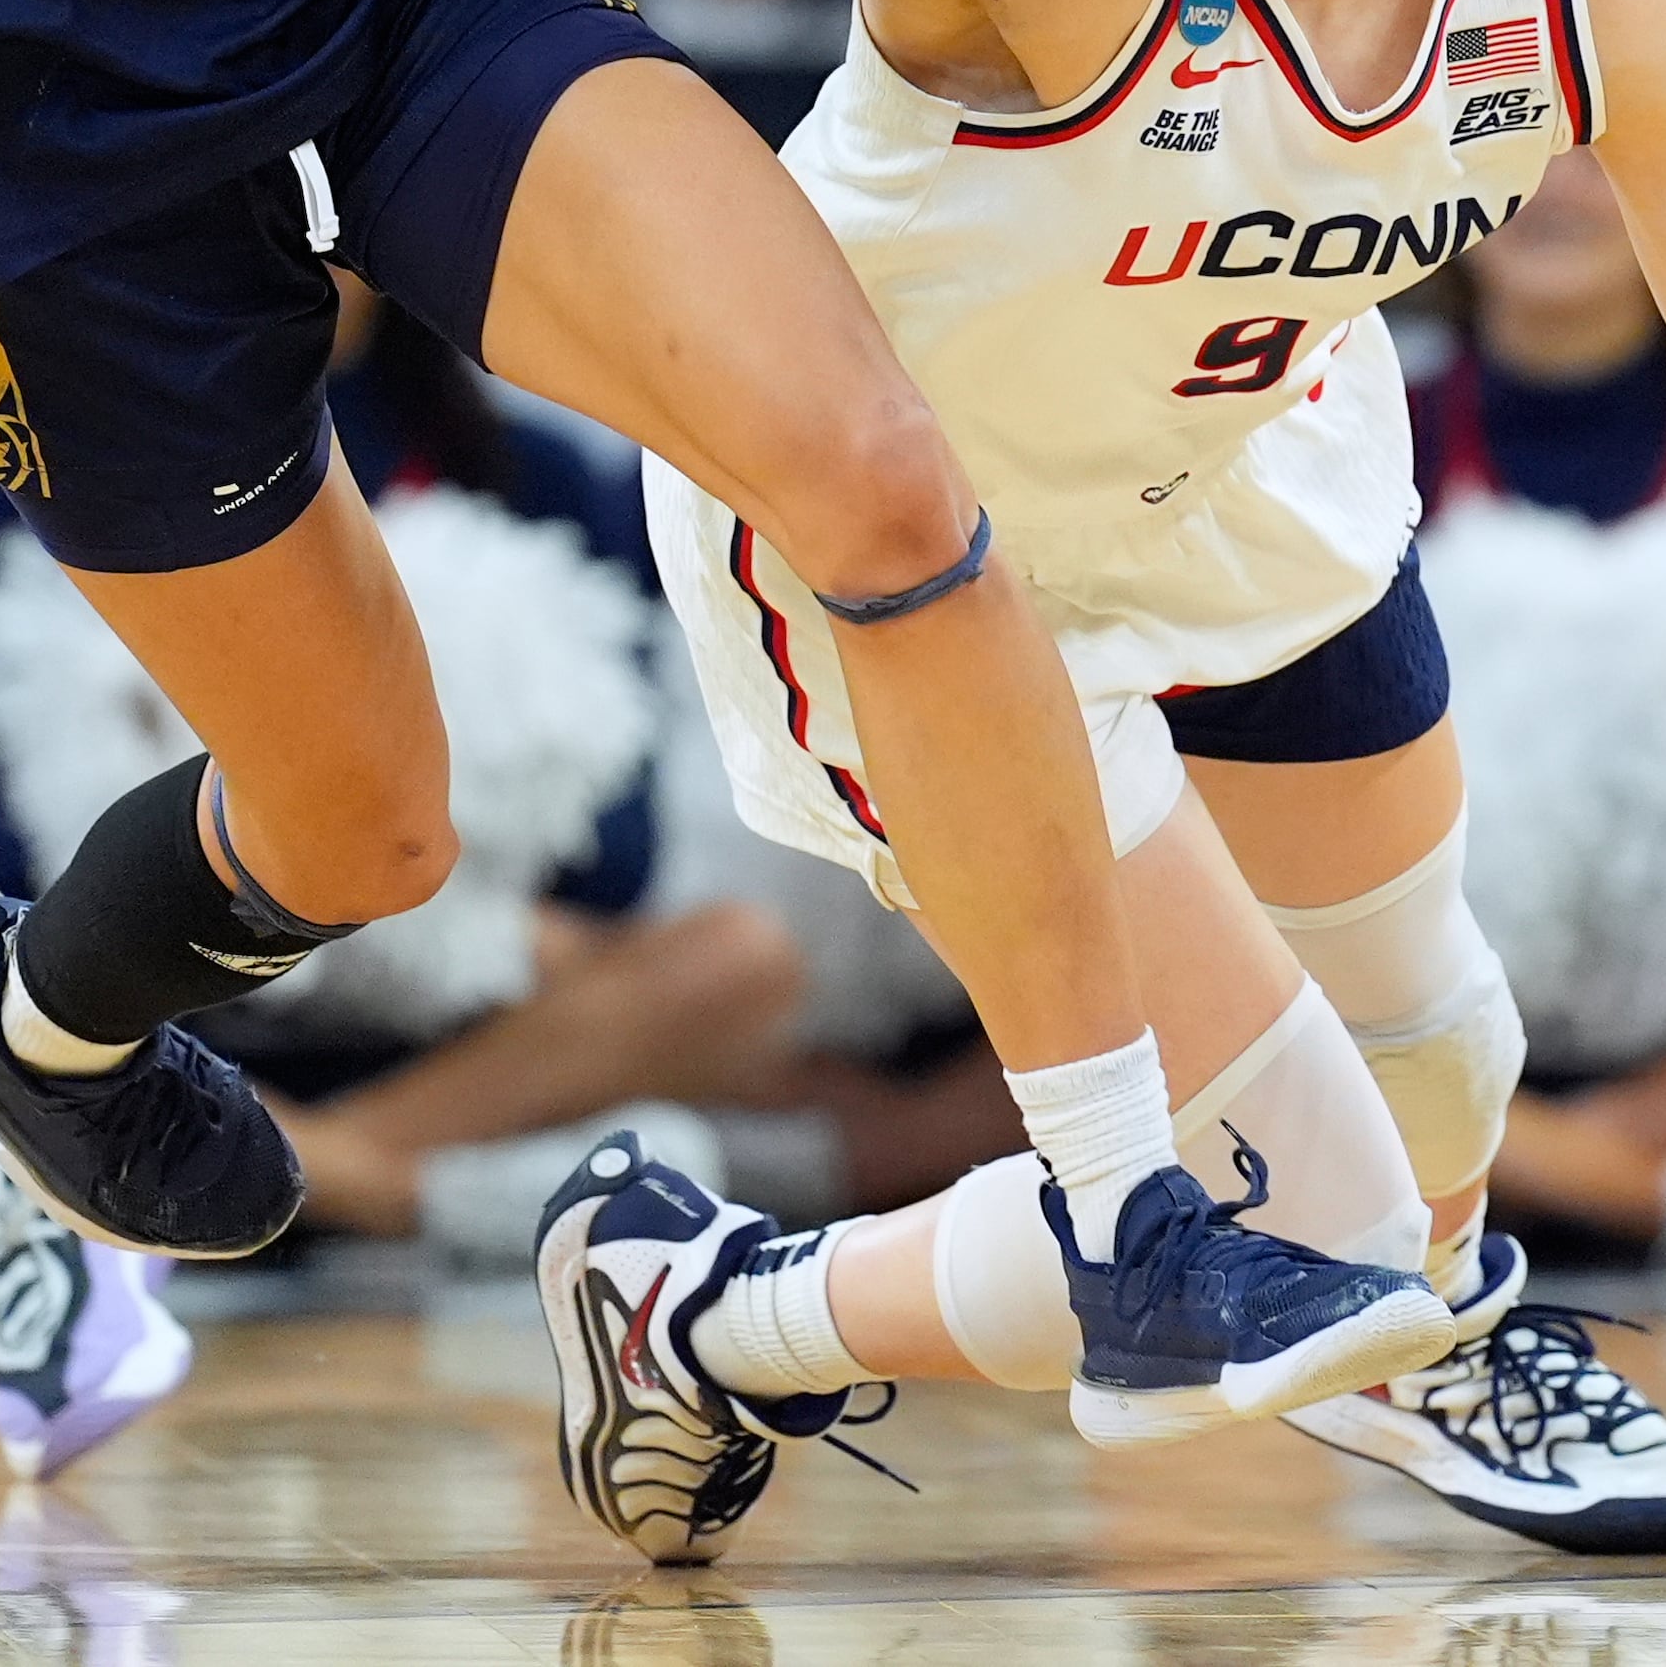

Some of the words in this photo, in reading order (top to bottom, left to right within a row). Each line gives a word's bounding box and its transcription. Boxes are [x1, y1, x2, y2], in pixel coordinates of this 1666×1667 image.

[1183, 4, 1229, 28] NCAA
[1462, 88, 1531, 116] BIG
[1155, 109, 1188, 131] BE
[1191, 108, 1220, 132] THE
[1452, 104, 1550, 135] EAST
[1139, 127, 1219, 153] CHANGE
[1102, 193, 1523, 287] UCONN
[1170, 315, 1309, 398] 9
[213, 484, 265, 515] UNDER
